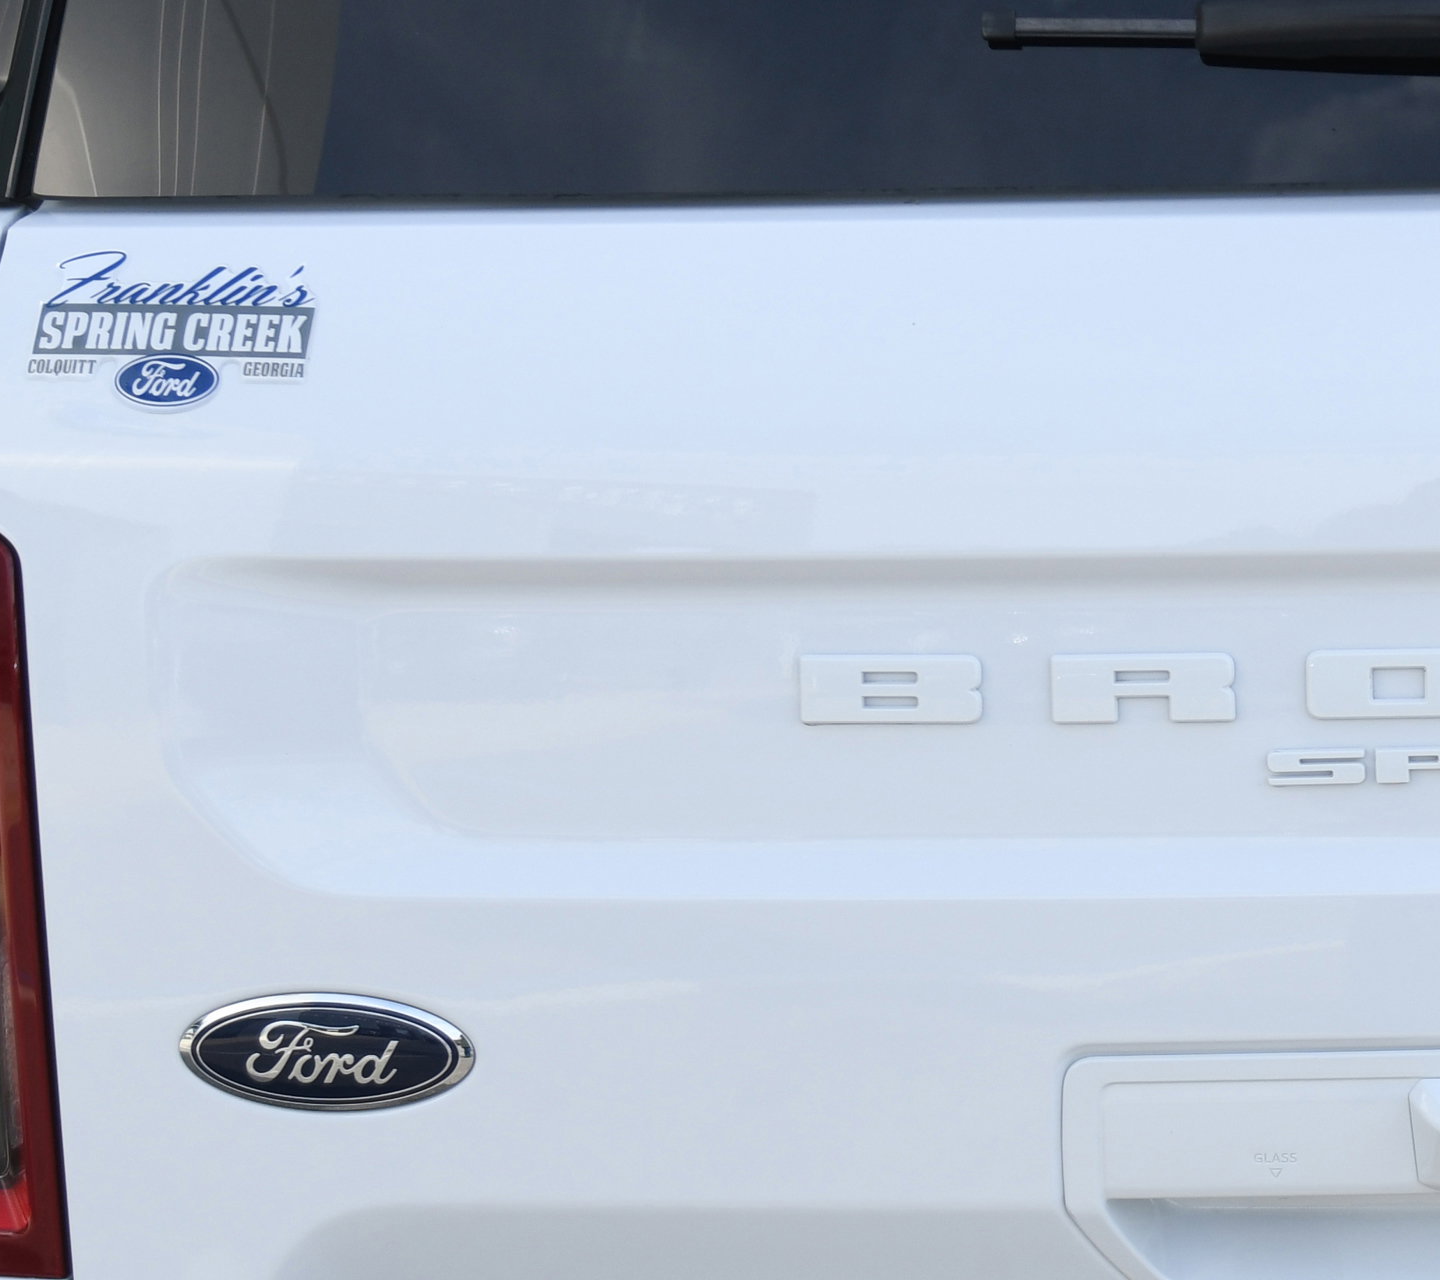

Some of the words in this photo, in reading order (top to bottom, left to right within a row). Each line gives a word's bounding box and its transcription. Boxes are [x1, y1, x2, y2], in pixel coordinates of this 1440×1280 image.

[43, 250, 316, 308] Franklin's
[38, 310, 177, 352] SPRING
[183, 312, 308, 354] CREEK
[27, 358, 97, 377] COLQUITT
[131, 360, 199, 398] Ford
[242, 361, 304, 378] GEORGIA
[245, 1020, 398, 1084] Ford
[1253, 1152, 1297, 1163] GLASS
